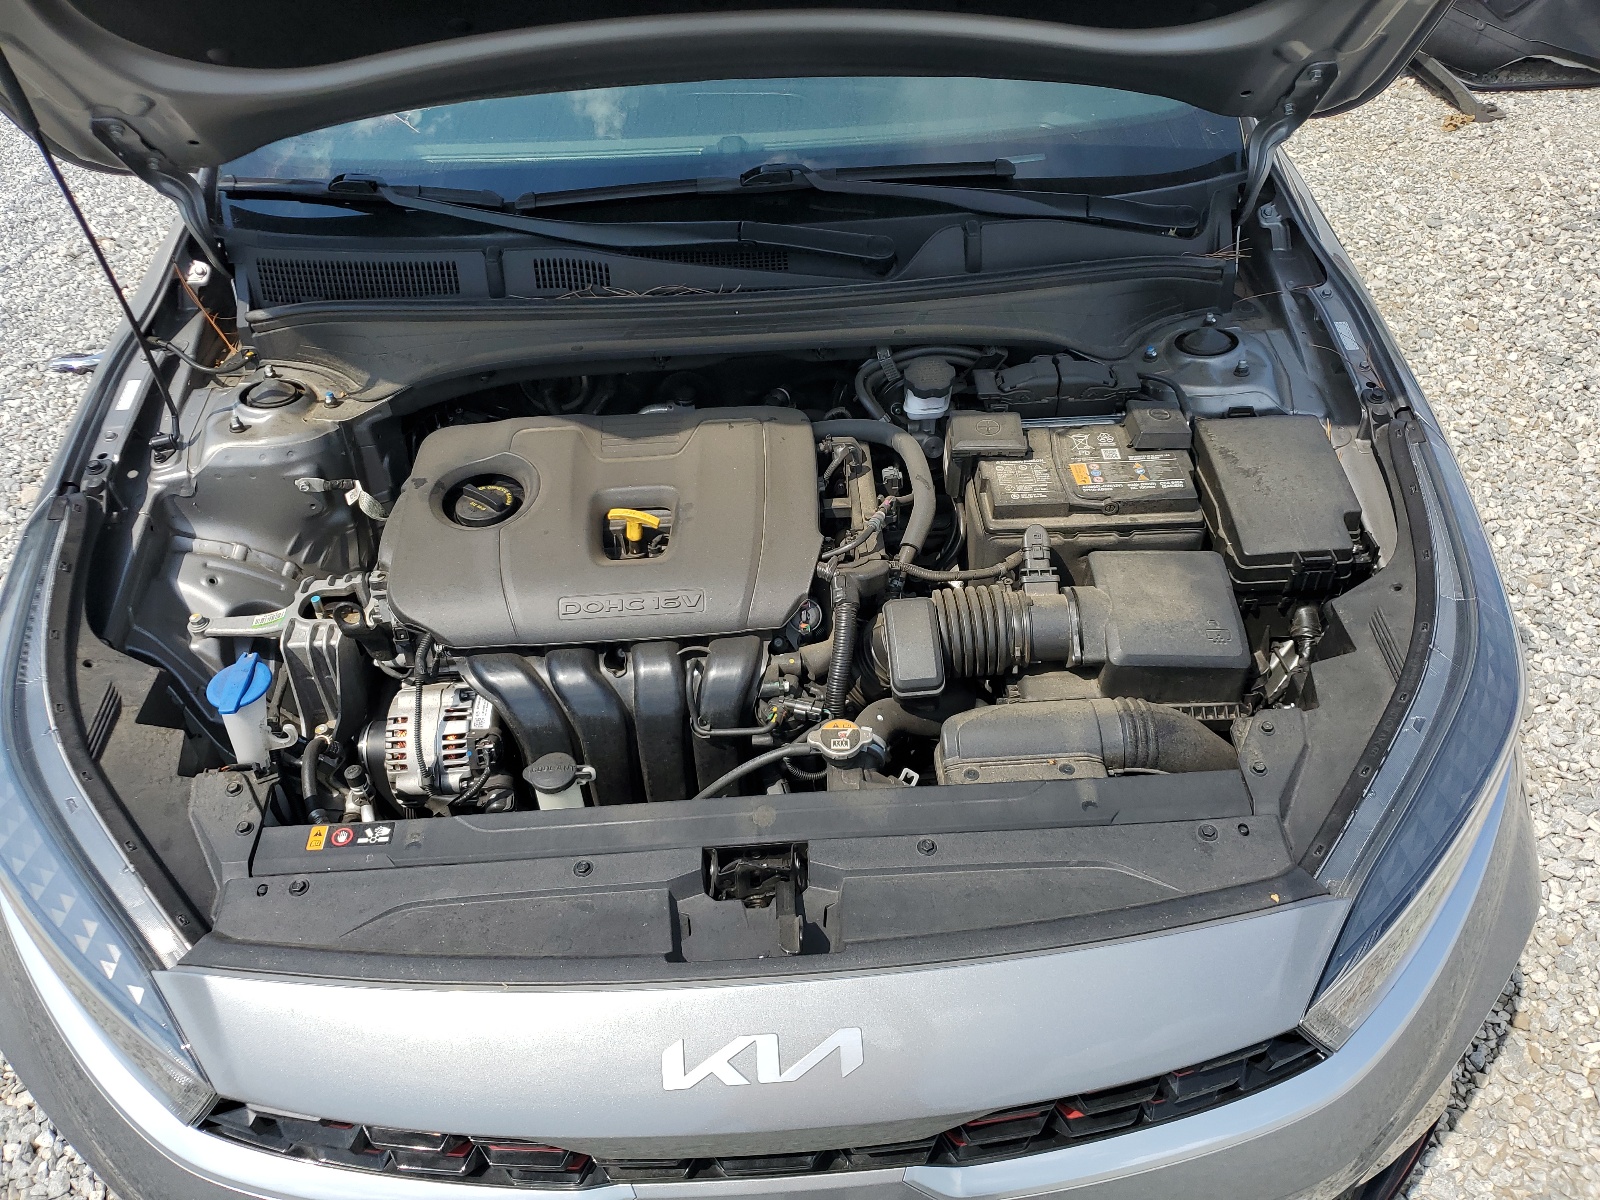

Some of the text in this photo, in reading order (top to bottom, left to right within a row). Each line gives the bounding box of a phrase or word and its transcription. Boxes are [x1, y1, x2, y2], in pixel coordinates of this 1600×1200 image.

[561, 594, 702, 615] DOHC 16V
[531, 764, 576, 773] COOLANT
[661, 1026, 865, 1092] KIA
